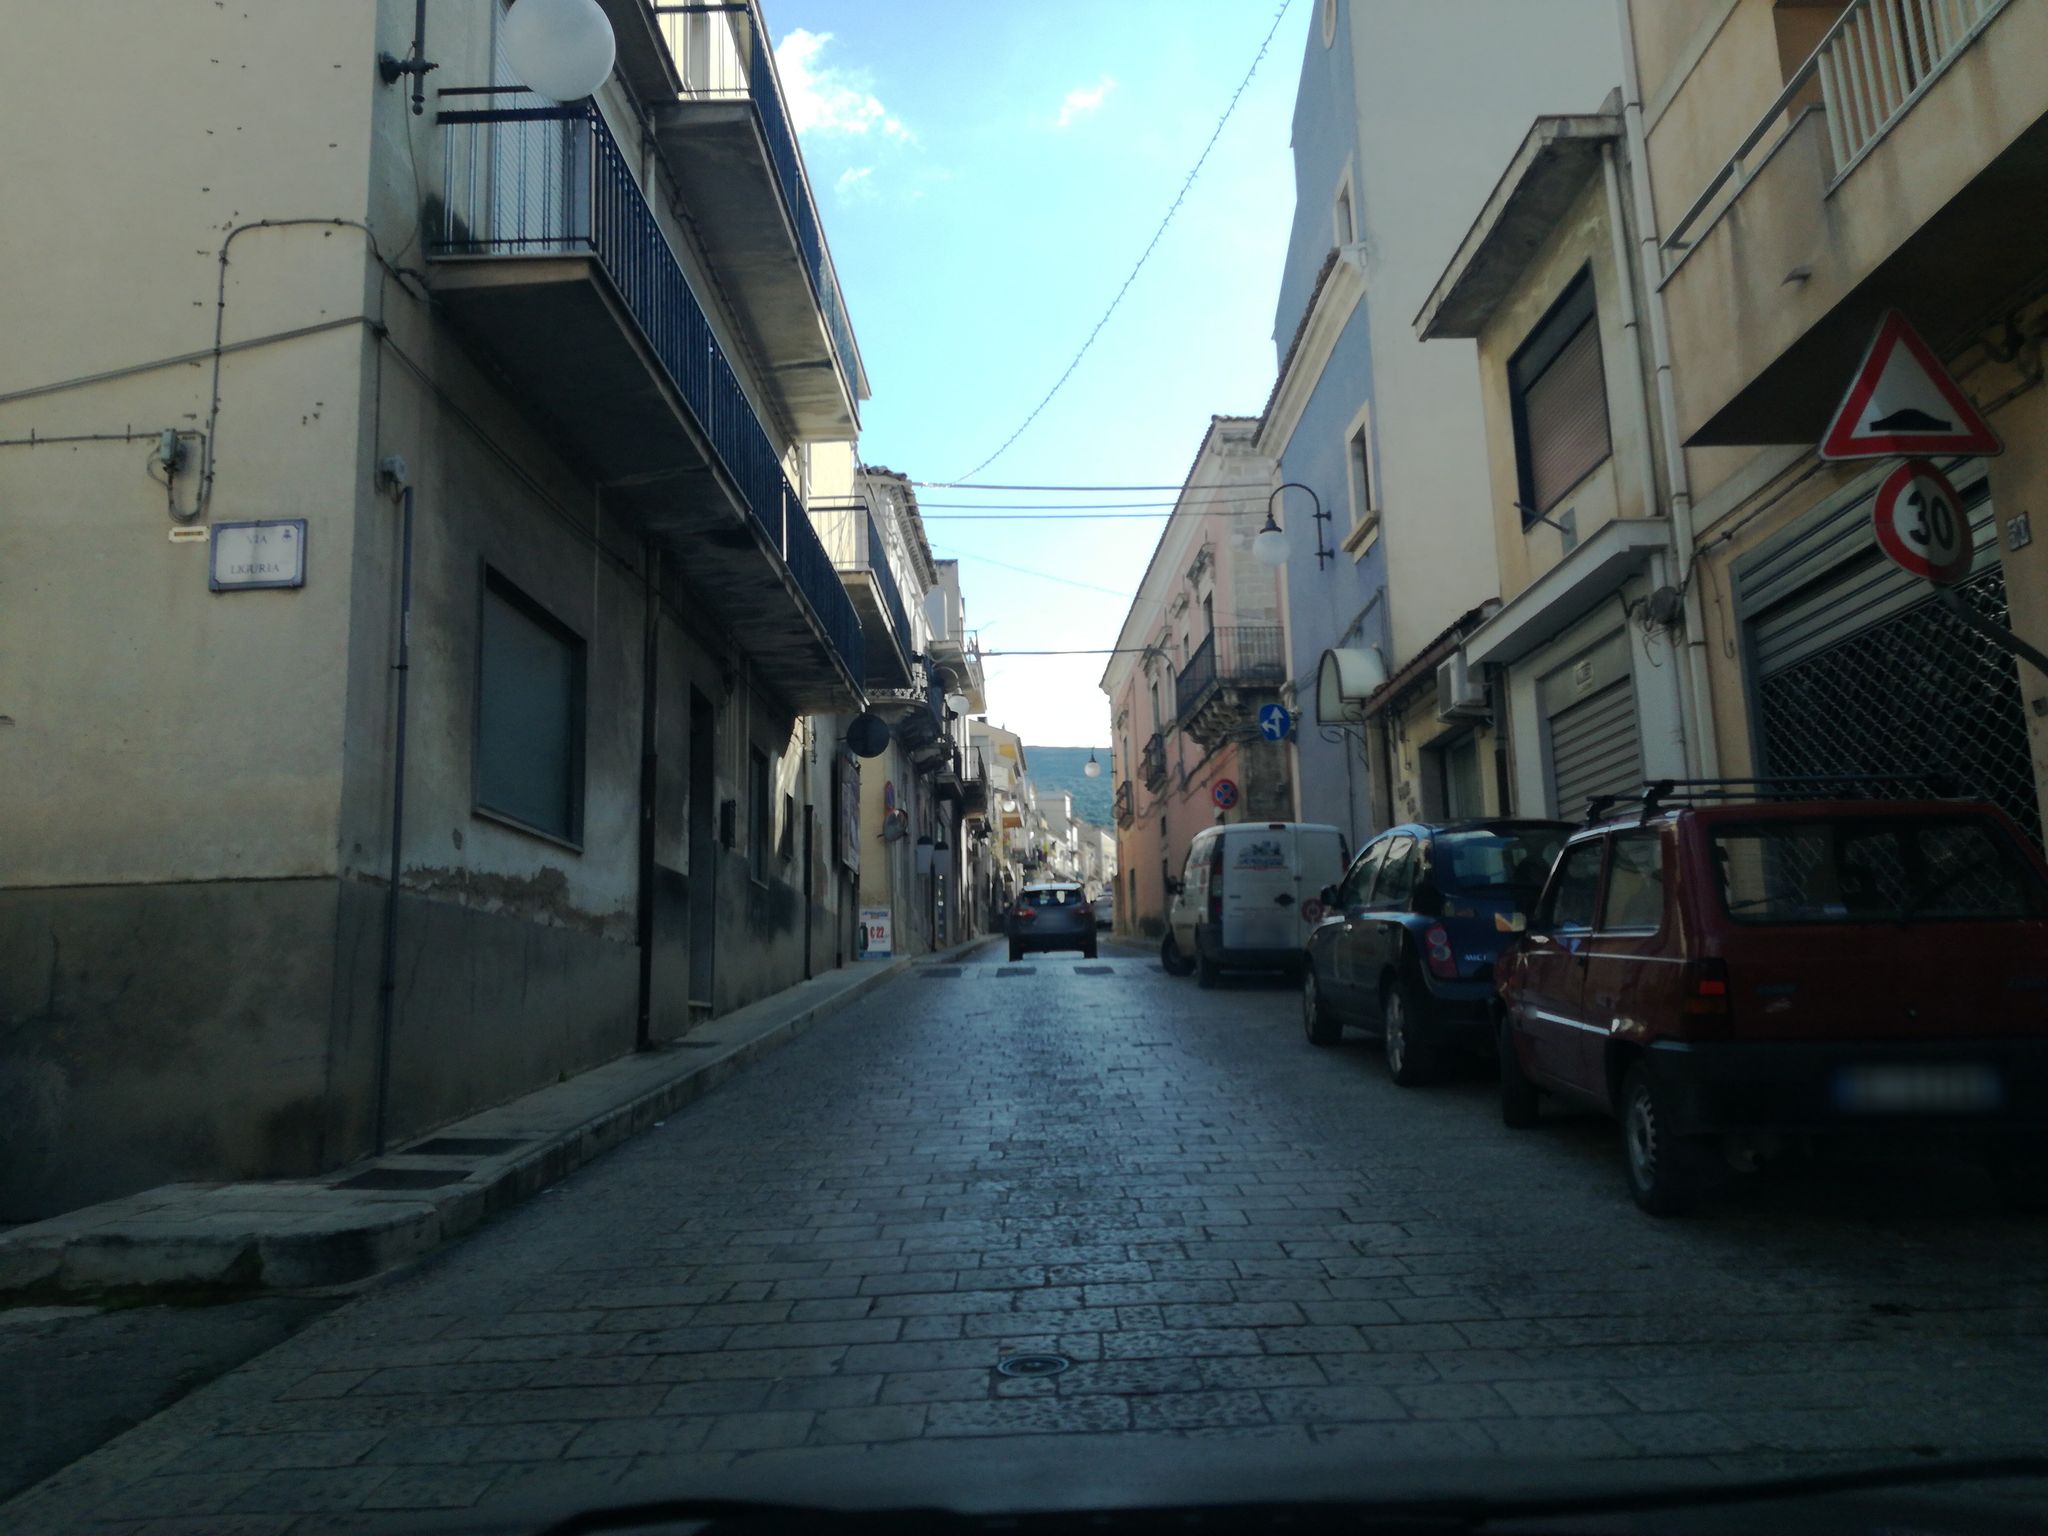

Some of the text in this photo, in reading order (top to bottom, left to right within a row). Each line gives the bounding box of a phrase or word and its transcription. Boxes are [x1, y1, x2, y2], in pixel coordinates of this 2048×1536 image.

[1907, 490, 1954, 550] 30
[246, 535, 268, 545] VIA
[230, 563, 280, 575] LIGURIA
